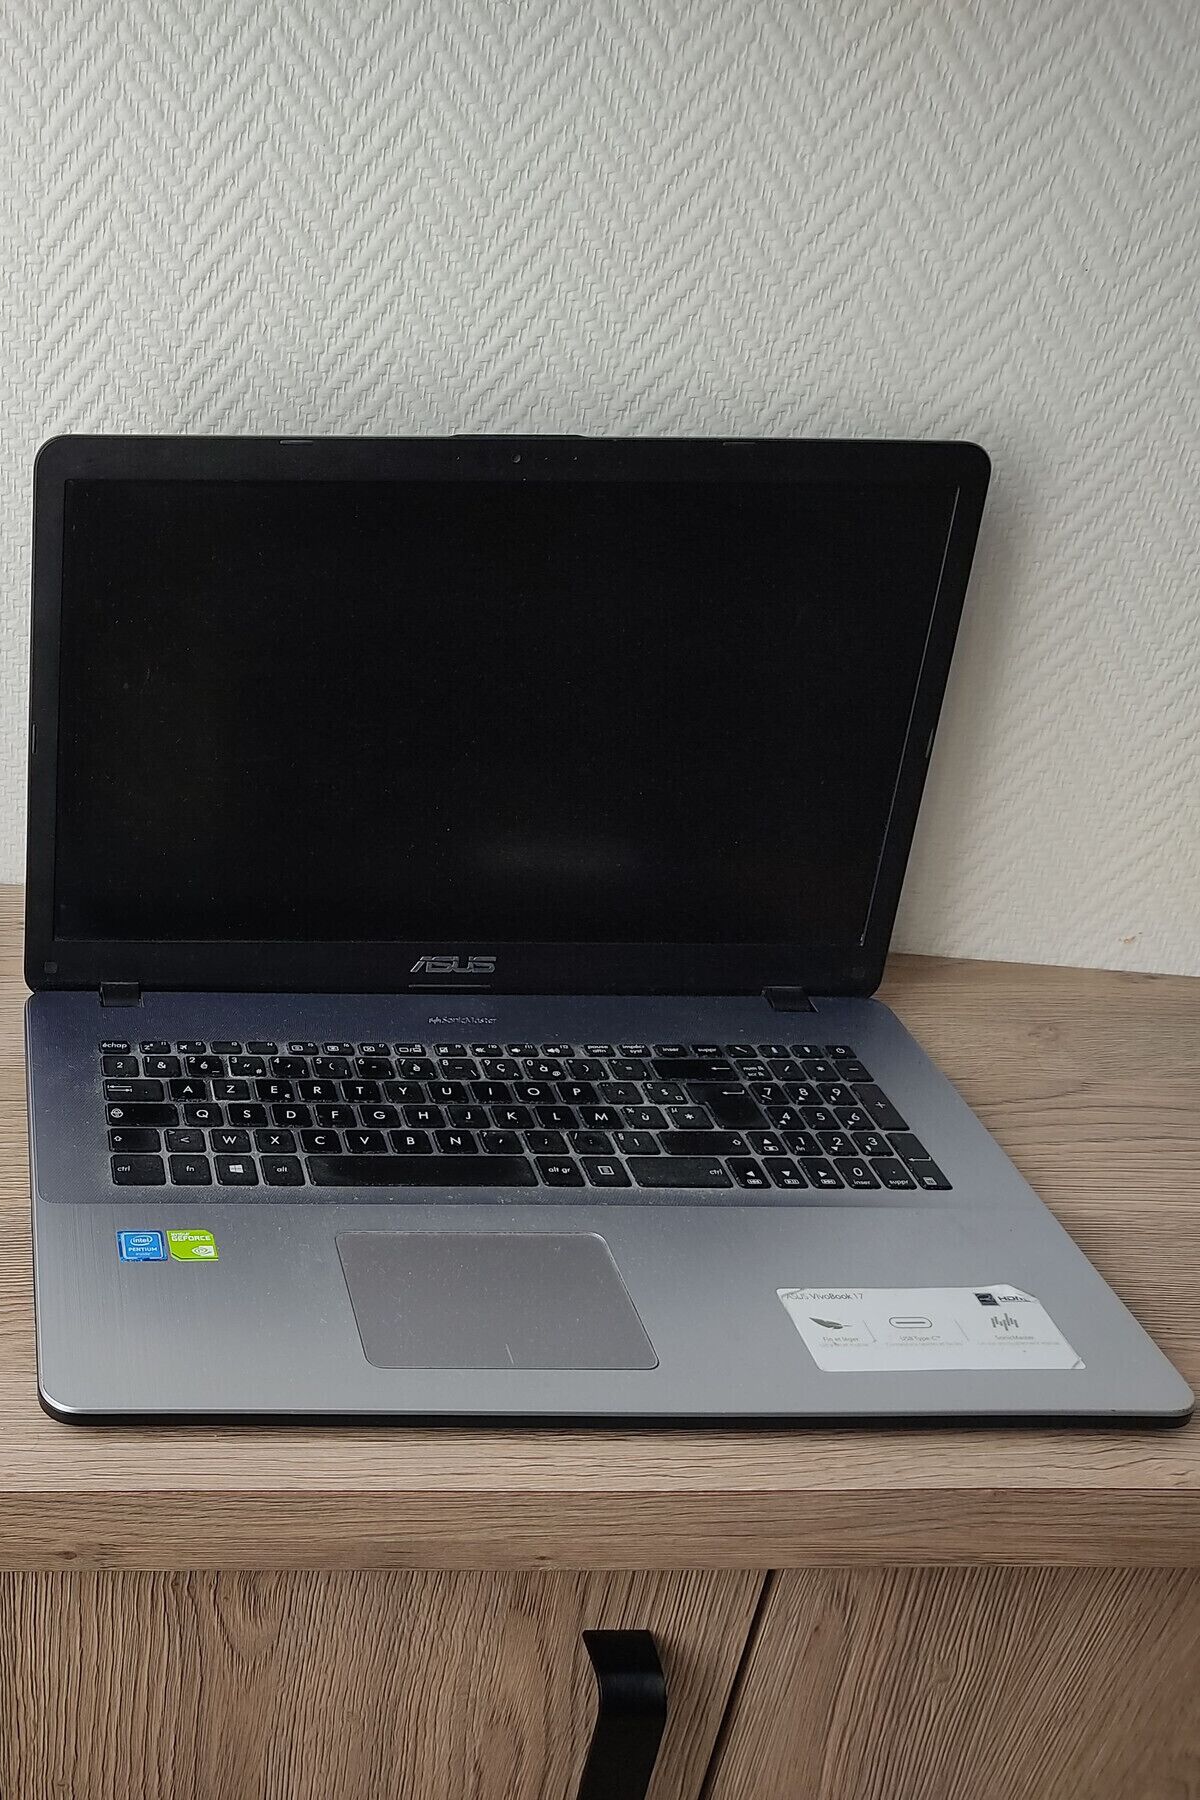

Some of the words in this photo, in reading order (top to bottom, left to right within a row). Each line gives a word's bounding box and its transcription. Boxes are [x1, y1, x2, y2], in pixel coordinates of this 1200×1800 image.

[410, 956, 497, 973] ASUS
[227, 1085, 235, 1093] Z
[763, 1088, 771, 1096] 7
[799, 1088, 808, 1097] 8
[832, 1089, 840, 1097] 9
[196, 1110, 208, 1118] Q
[244, 1110, 250, 1118] S
[374, 1111, 385, 1119] G
[782, 1113, 790, 1121] 4
[223, 1136, 236, 1144] W
[271, 1136, 279, 1144] X
[315, 1136, 325, 1144] C
[407, 1137, 415, 1145] B
[798, 1137, 805, 1145] 1
[833, 1137, 843, 1145] 2
[867, 1137, 877, 1146] 3
[853, 1168, 863, 1176] 0
[809, 1292, 852, 1300] VivoBook
